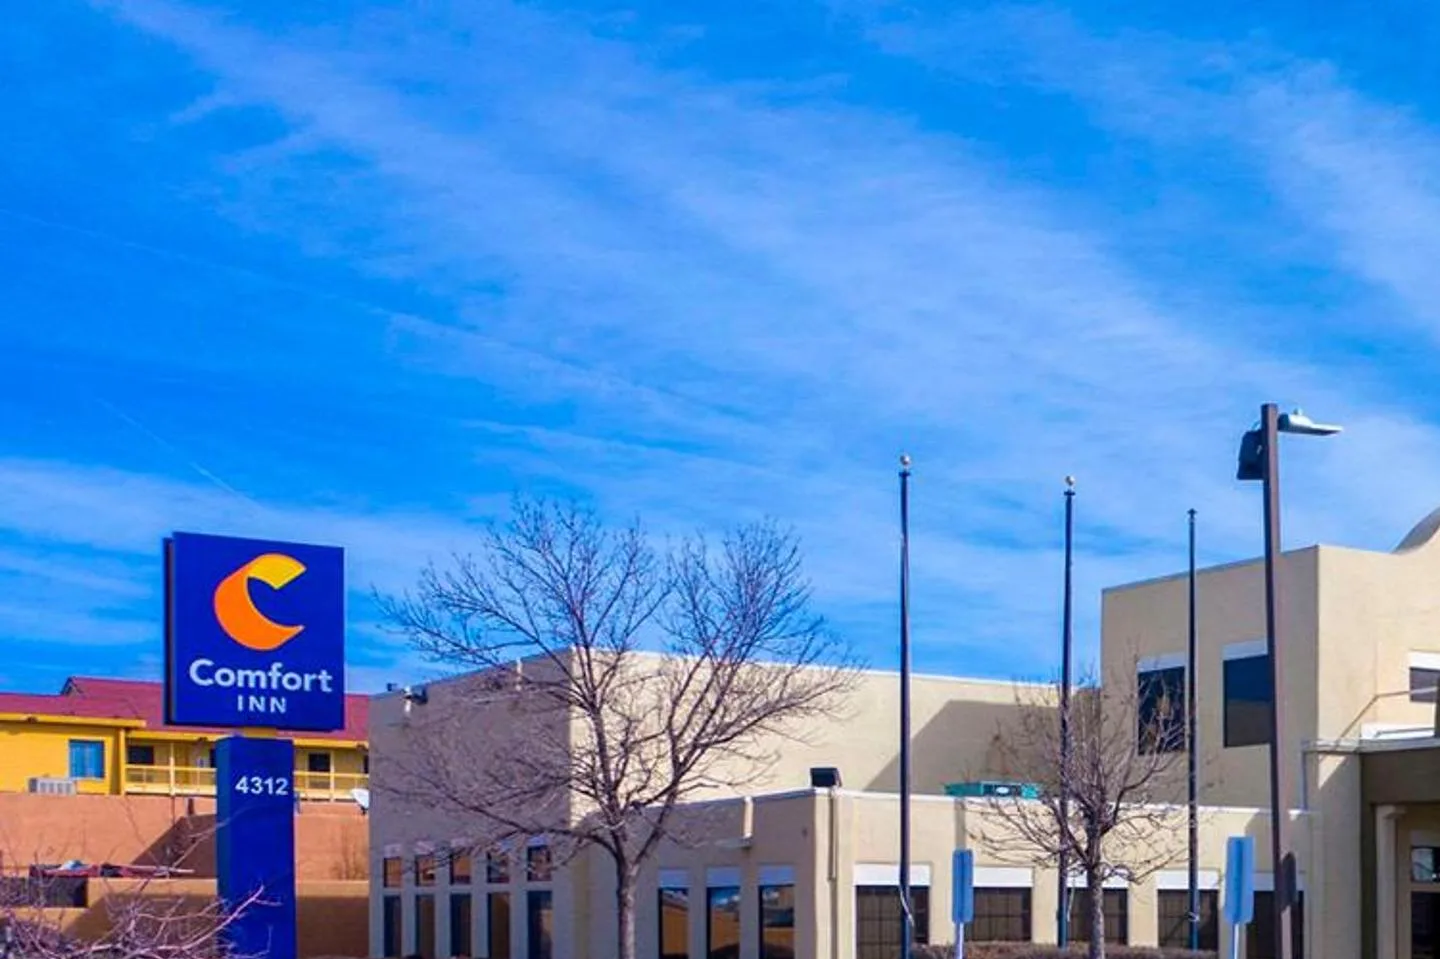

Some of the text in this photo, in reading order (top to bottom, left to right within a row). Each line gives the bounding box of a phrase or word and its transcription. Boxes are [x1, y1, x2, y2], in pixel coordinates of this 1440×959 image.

[189, 658, 333, 693] Comfort
[237, 695, 286, 713] INN
[235, 776, 289, 795] 4312
